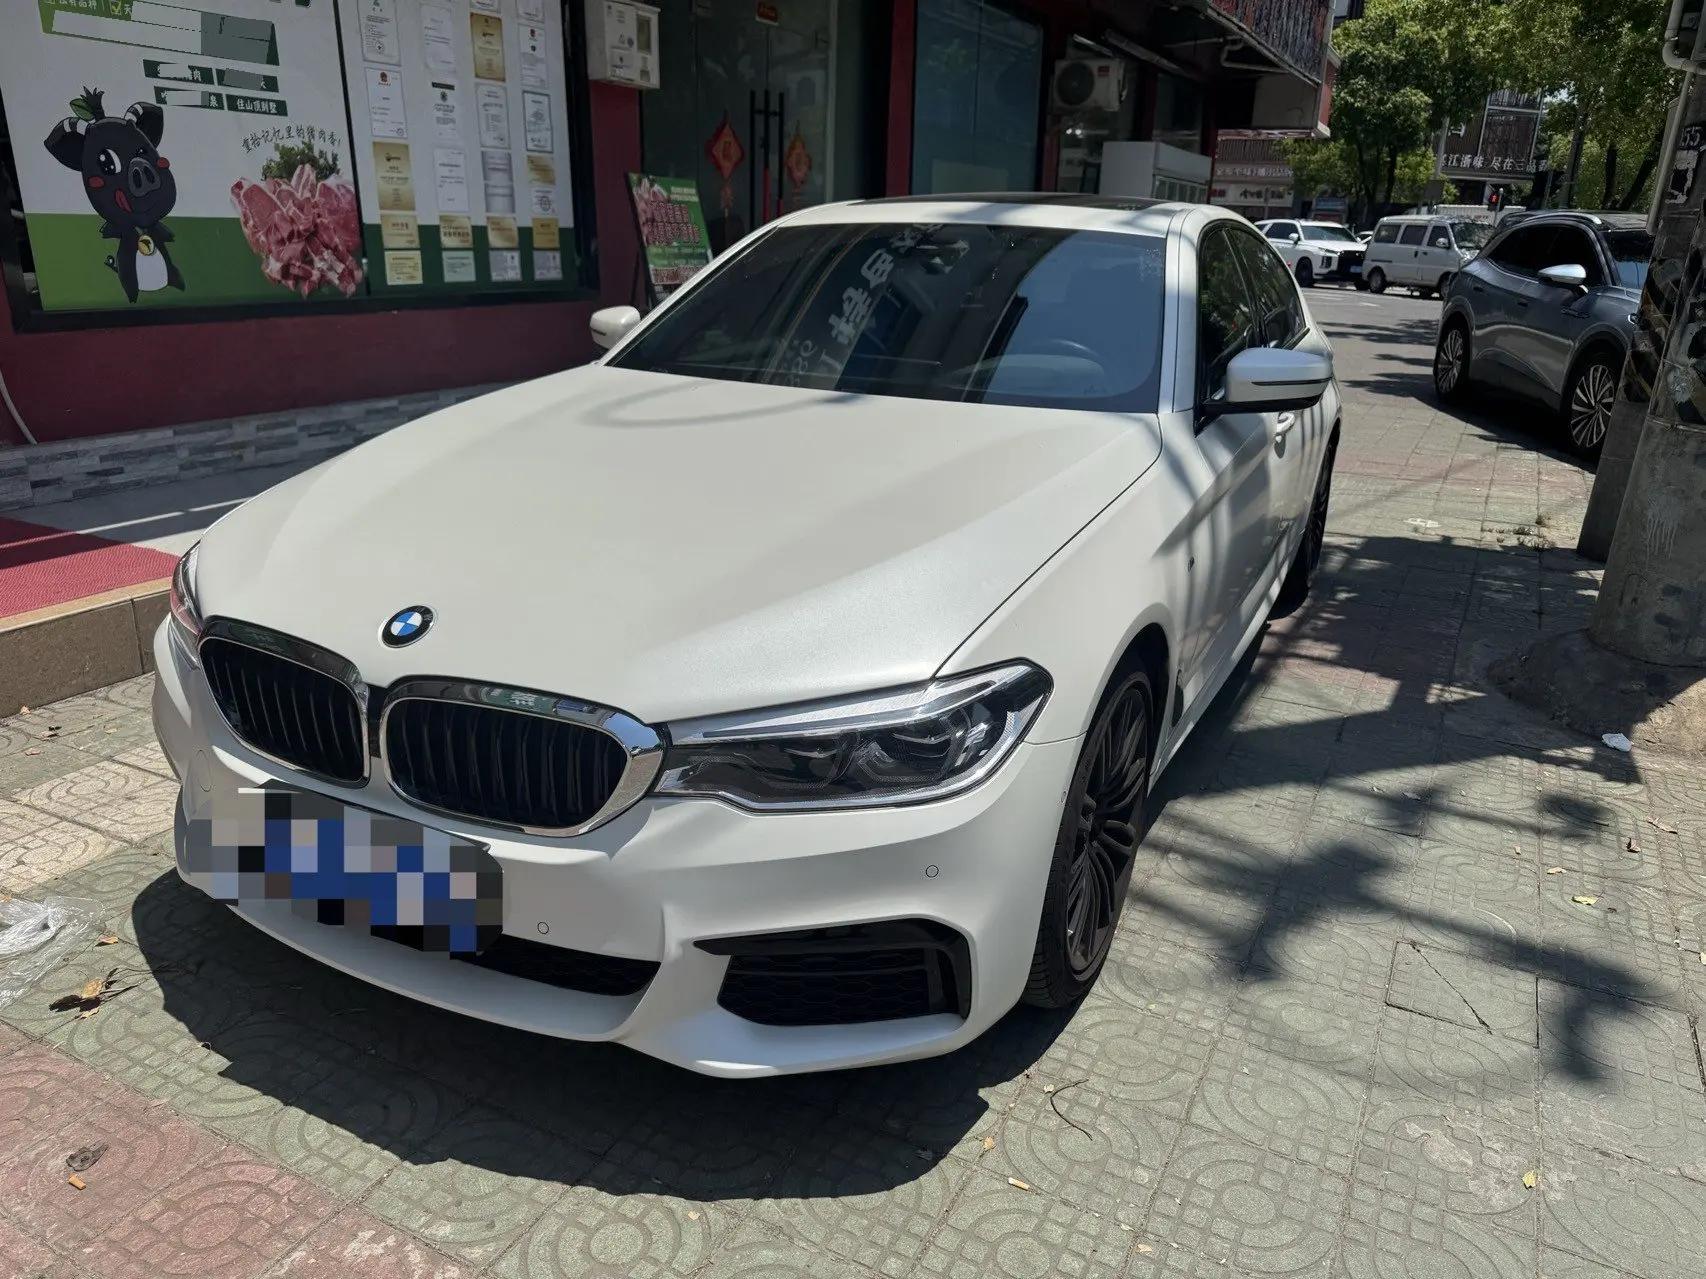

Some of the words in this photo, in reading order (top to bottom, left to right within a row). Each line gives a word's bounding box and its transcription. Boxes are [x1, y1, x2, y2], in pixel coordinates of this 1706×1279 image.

[236, 98, 277, 113] 住山顶别墅
